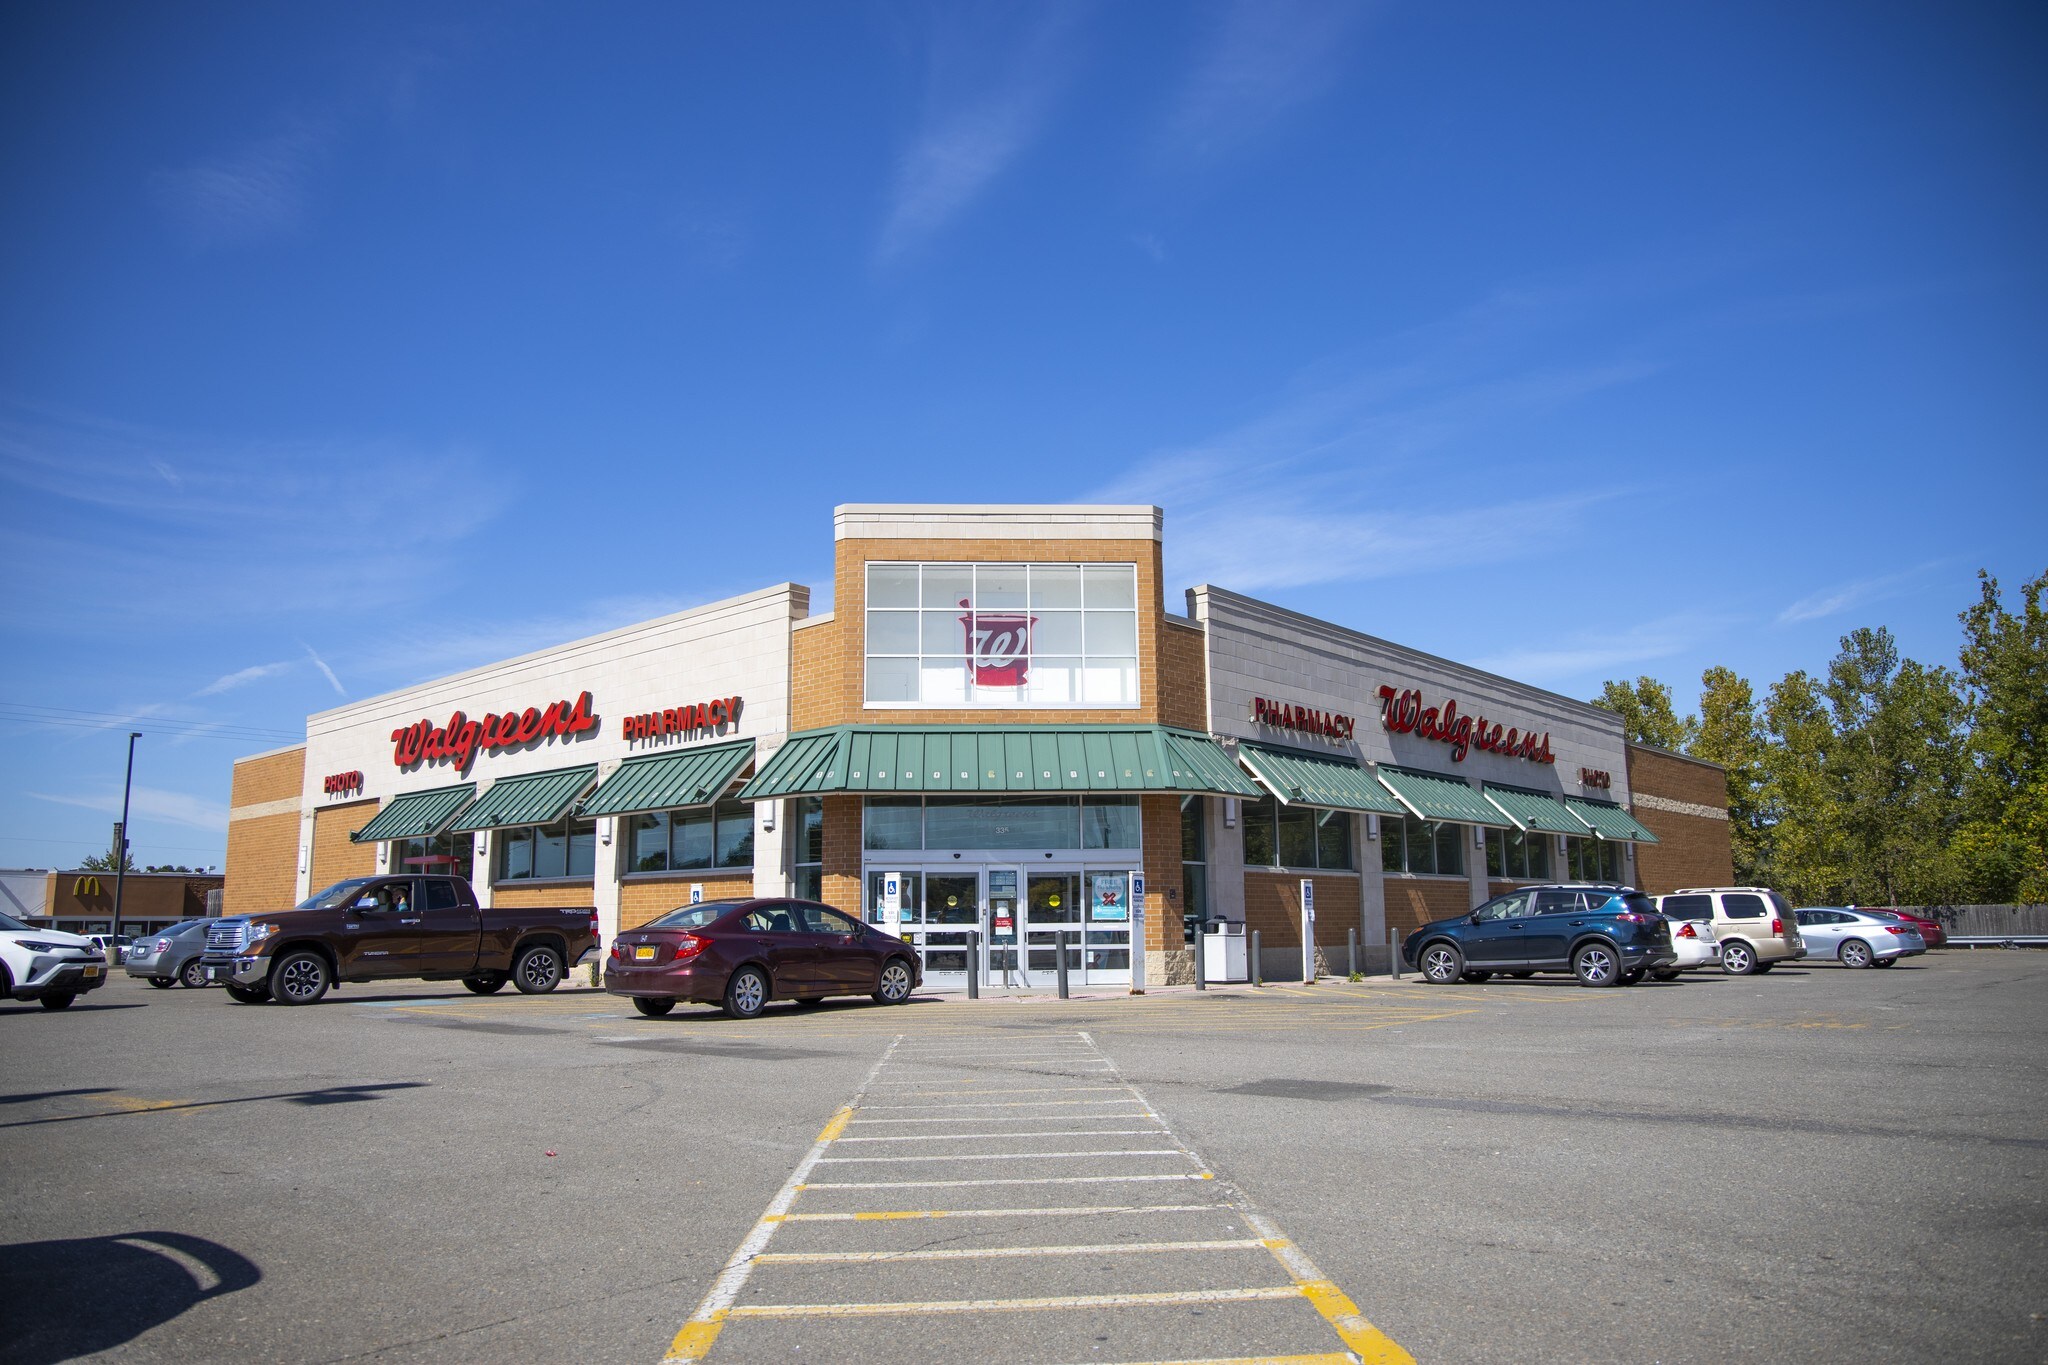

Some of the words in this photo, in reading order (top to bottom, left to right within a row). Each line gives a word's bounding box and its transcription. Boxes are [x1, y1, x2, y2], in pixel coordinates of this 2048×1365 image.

[390, 690, 597, 772] Walgreens
[622, 695, 741, 741] PHARMACY
[1253, 696, 1356, 741] PHARMACY
[1377, 684, 1556, 764] Walgreens
[323, 769, 360, 794] PHOTO
[1580, 767, 1611, 790] PHOTO
